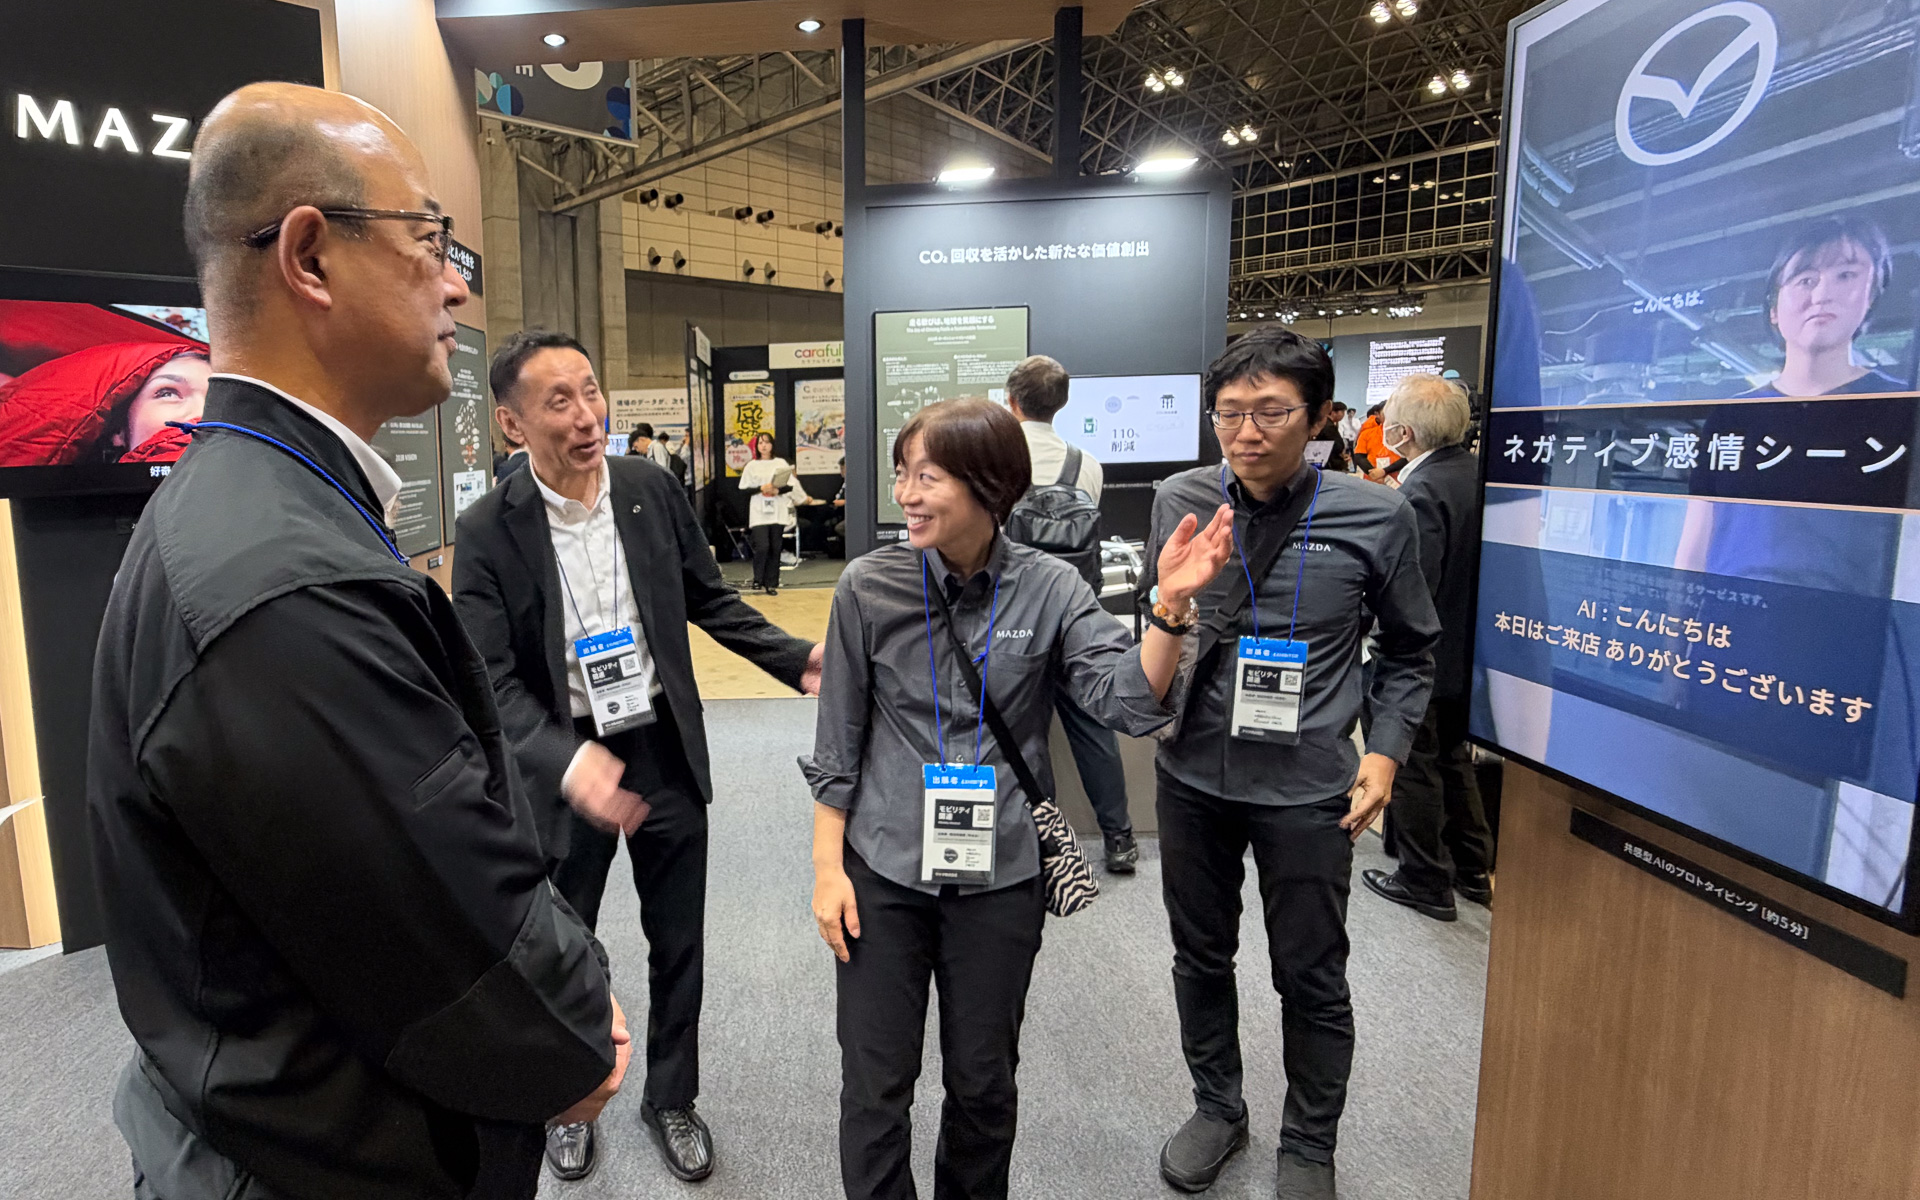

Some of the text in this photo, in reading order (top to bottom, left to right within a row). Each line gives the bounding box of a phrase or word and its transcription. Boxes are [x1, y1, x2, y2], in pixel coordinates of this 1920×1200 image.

[17, 93, 192, 160] MAZ
[950, 241, 1150, 264] 回収を活かした新たな価値創出
[794, 343, 841, 358] caraful
[616, 420, 629, 430] 01
[1111, 441, 1135, 453] 削減
[1503, 432, 1907, 473] ネガティブ感情シーン
[1292, 542, 1331, 552] MAZDA
[996, 628, 1034, 639] MAZDA
[591, 661, 618, 674] モビリティ
[1494, 611, 1873, 723] 本日はご来店 ありがとうございます
[939, 805, 970, 814] モビリティ
[1623, 841, 1757, 912] 共感型AIのプロトタイピング
